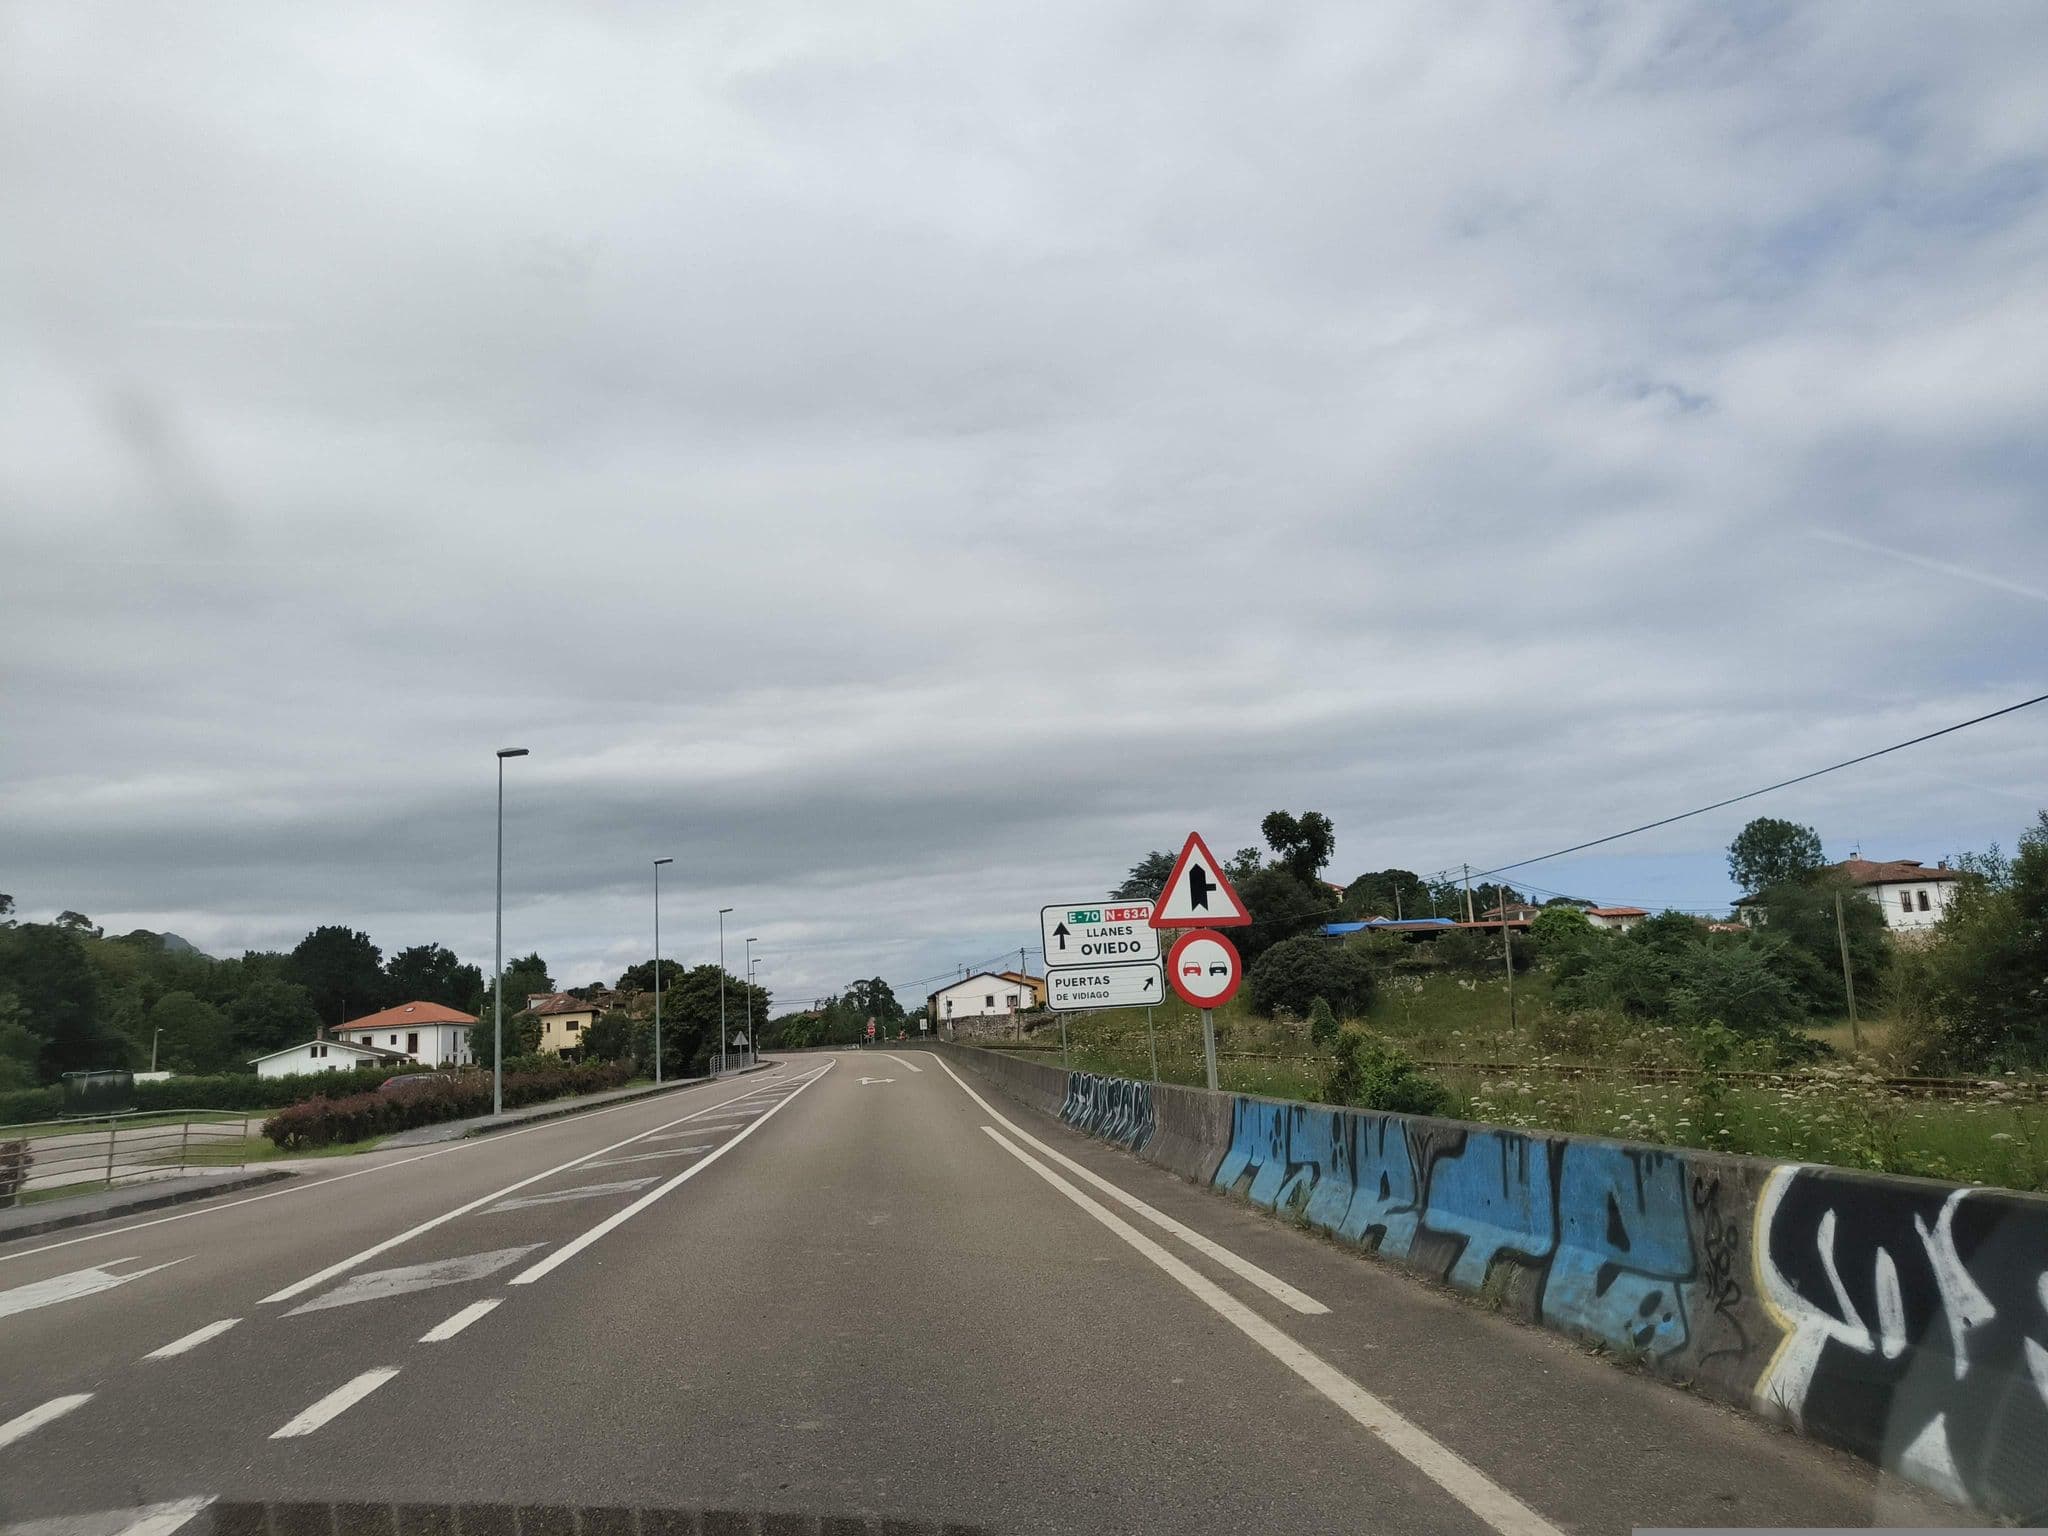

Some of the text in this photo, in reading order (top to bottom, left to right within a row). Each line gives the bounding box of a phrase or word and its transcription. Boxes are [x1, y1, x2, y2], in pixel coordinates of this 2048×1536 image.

[1068, 908, 1147, 923] E-70 N-634
[1087, 926, 1133, 938] LLANES
[1081, 941, 1141, 955] OVIEDO
[1055, 976, 1110, 988] PUERTAS
[1056, 991, 1109, 1001] DE VIDIAGO
